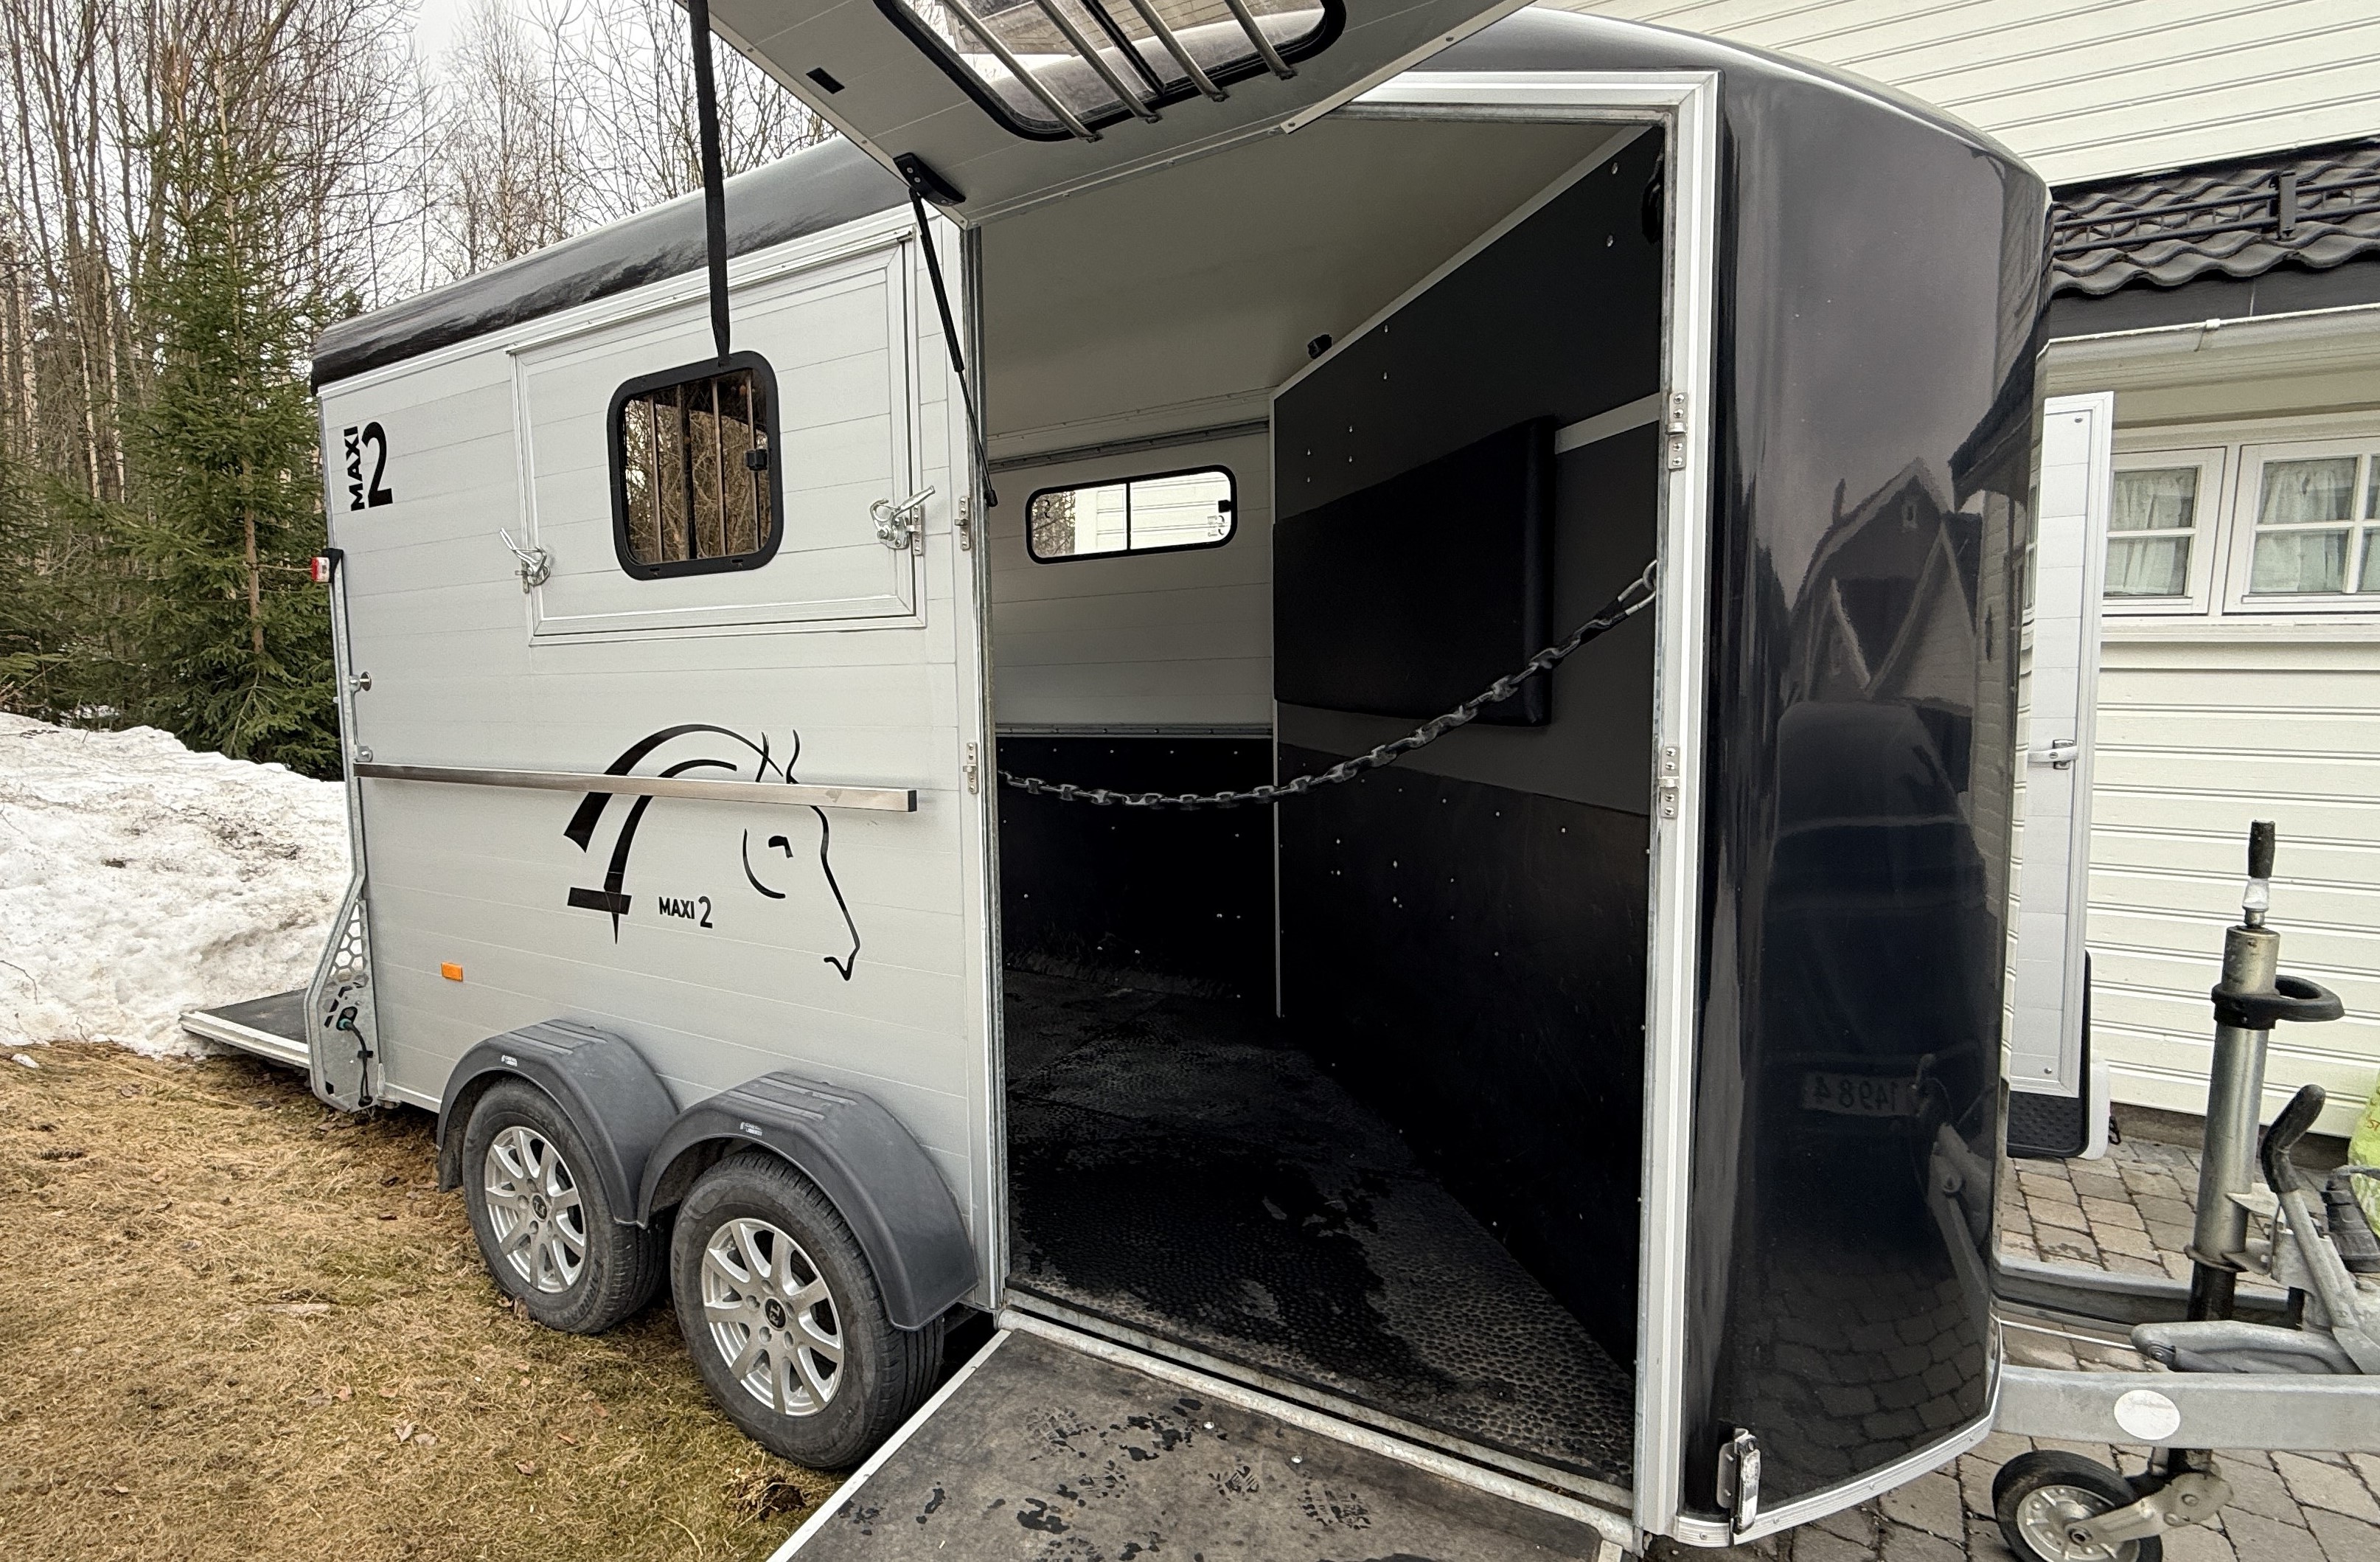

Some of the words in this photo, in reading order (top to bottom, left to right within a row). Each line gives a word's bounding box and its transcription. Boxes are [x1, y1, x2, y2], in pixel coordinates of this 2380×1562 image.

[344, 426, 365, 511] MAXI
[361, 422, 393, 507] 2
[658, 896, 695, 920] MAXI
[698, 895, 713, 929] 2
